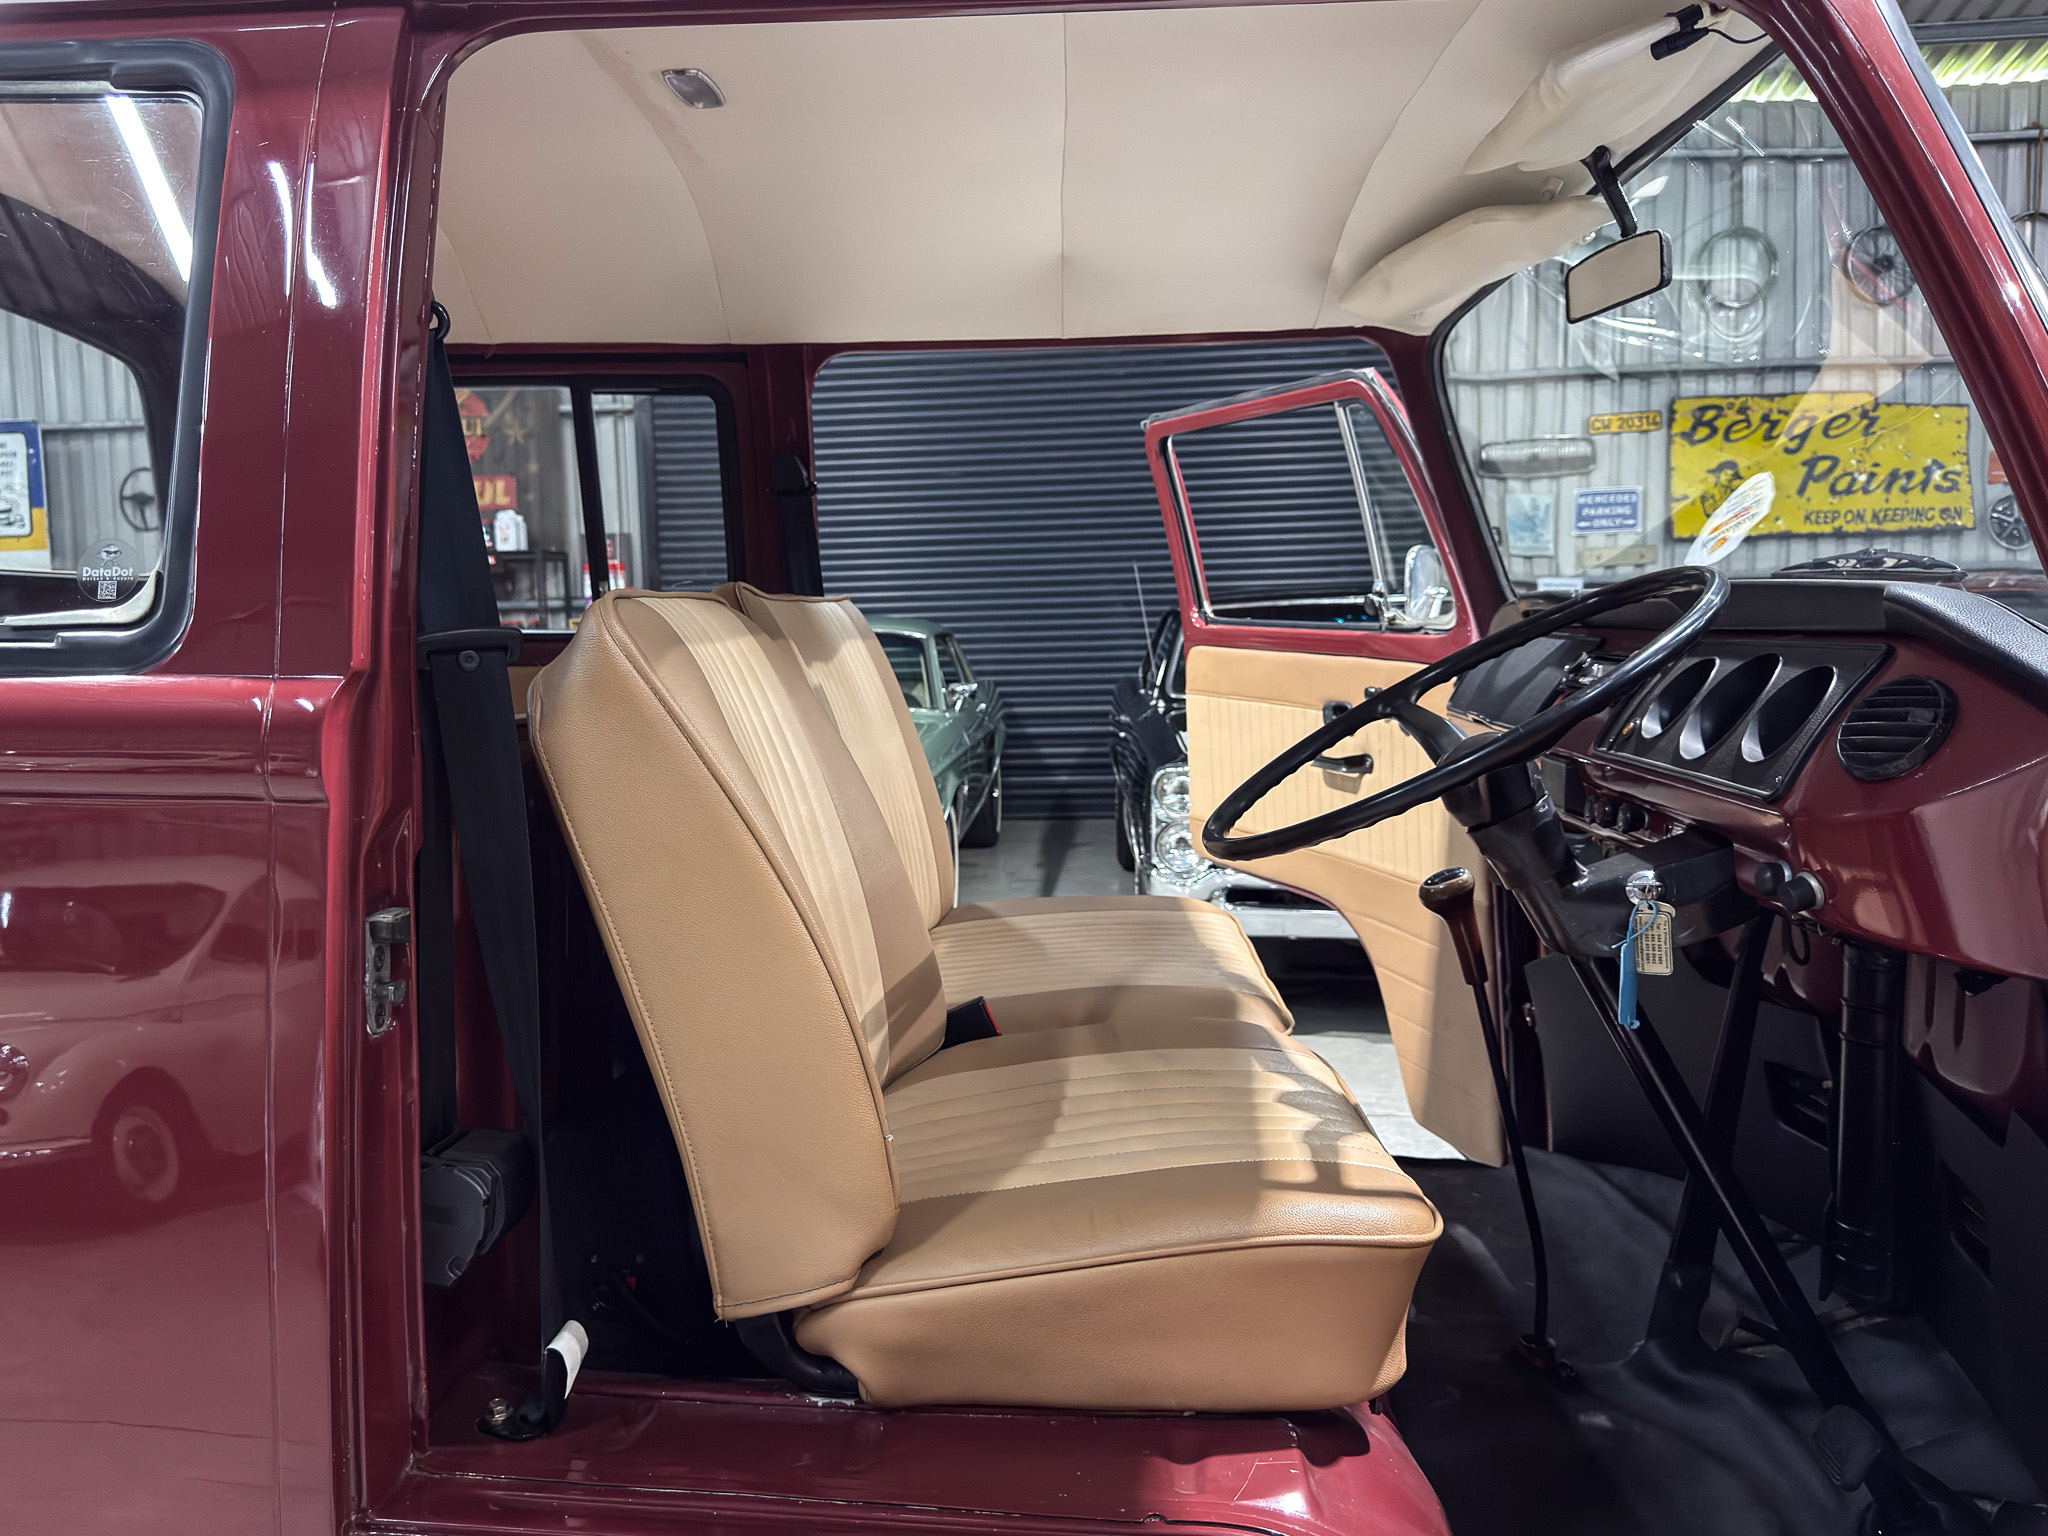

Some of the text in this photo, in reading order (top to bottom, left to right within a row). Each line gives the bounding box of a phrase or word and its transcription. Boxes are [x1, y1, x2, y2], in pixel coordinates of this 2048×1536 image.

[1680, 403, 1881, 454] Berger
[1796, 455, 1962, 498] Paints
[1581, 505, 1632, 516] PARKING
[1804, 509, 1841, 525] KEEP
[1843, 508, 1867, 524] ON
[1592, 518, 1623, 529] ONLY
[82, 566, 134, 577] DataDot
